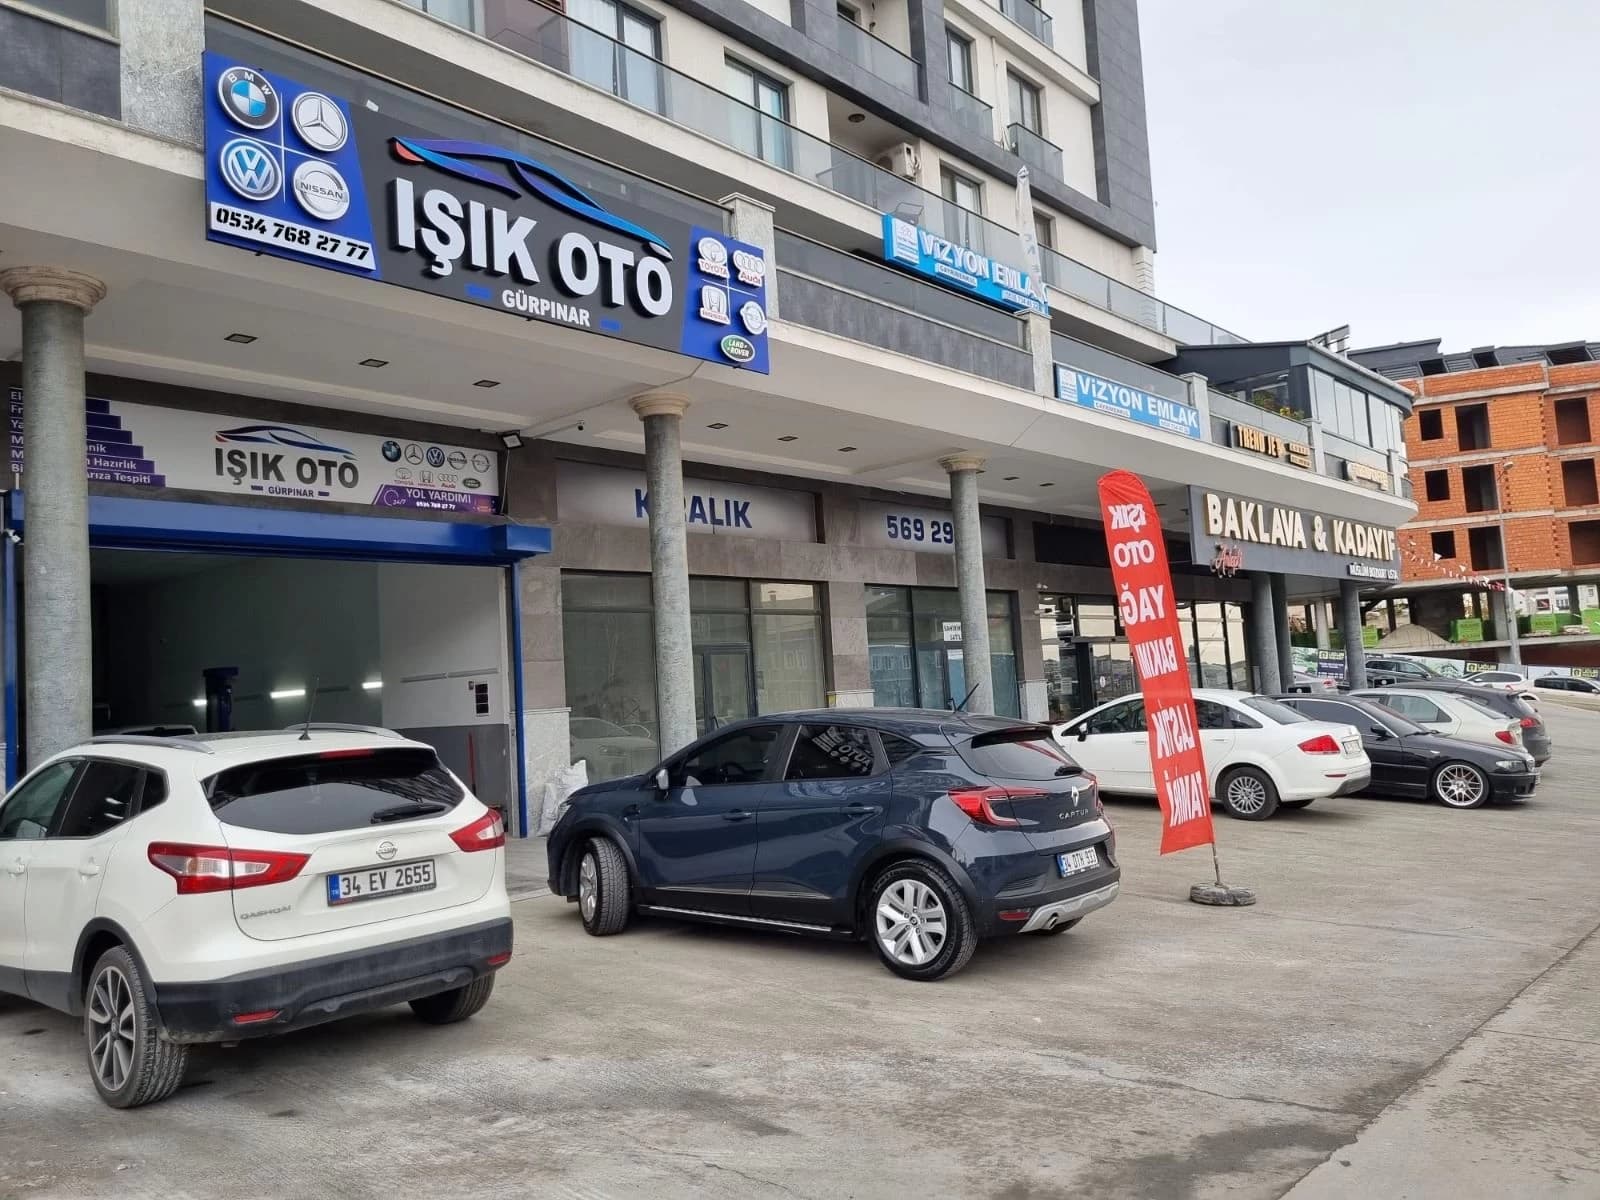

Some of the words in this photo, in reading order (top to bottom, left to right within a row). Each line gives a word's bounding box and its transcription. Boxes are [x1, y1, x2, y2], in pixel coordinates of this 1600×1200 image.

[299, 182, 344, 199] NISSAN
[216, 207, 267, 235] 0534
[273, 223, 311, 246] 768
[316, 234, 341, 254] 27
[346, 243, 370, 261] 77
[396, 177, 540, 283] IŞIK
[558, 232, 673, 316] OTO
[700, 260, 728, 276] TOYOTA
[502, 289, 590, 327] GÜRPINAR
[1147, 397, 1198, 428] EMLAK
[94, 457, 137, 470] Hazırlık
[215, 447, 285, 485] IŞIK
[296, 457, 359, 488] OTO
[113, 473, 151, 484] Tespiti
[268, 485, 314, 498] GÜRPINAR
[406, 488, 426, 499] YOL
[428, 490, 471, 503] YARDIMI
[634, 489, 753, 528] KALIK
[886, 515, 925, 542] 569
[931, 521, 954, 544] 29
[1207, 493, 1307, 549] BAKLAVA
[1314, 515, 1329, 552] &
[1332, 519, 1396, 561] KADAYIF
[1059, 808, 1089, 820] CAPTUR
[341, 875, 361, 895] 34
[369, 871, 387, 891] EV
[395, 864, 431, 887] 2655
[240, 905, 291, 920] QASHQAI
